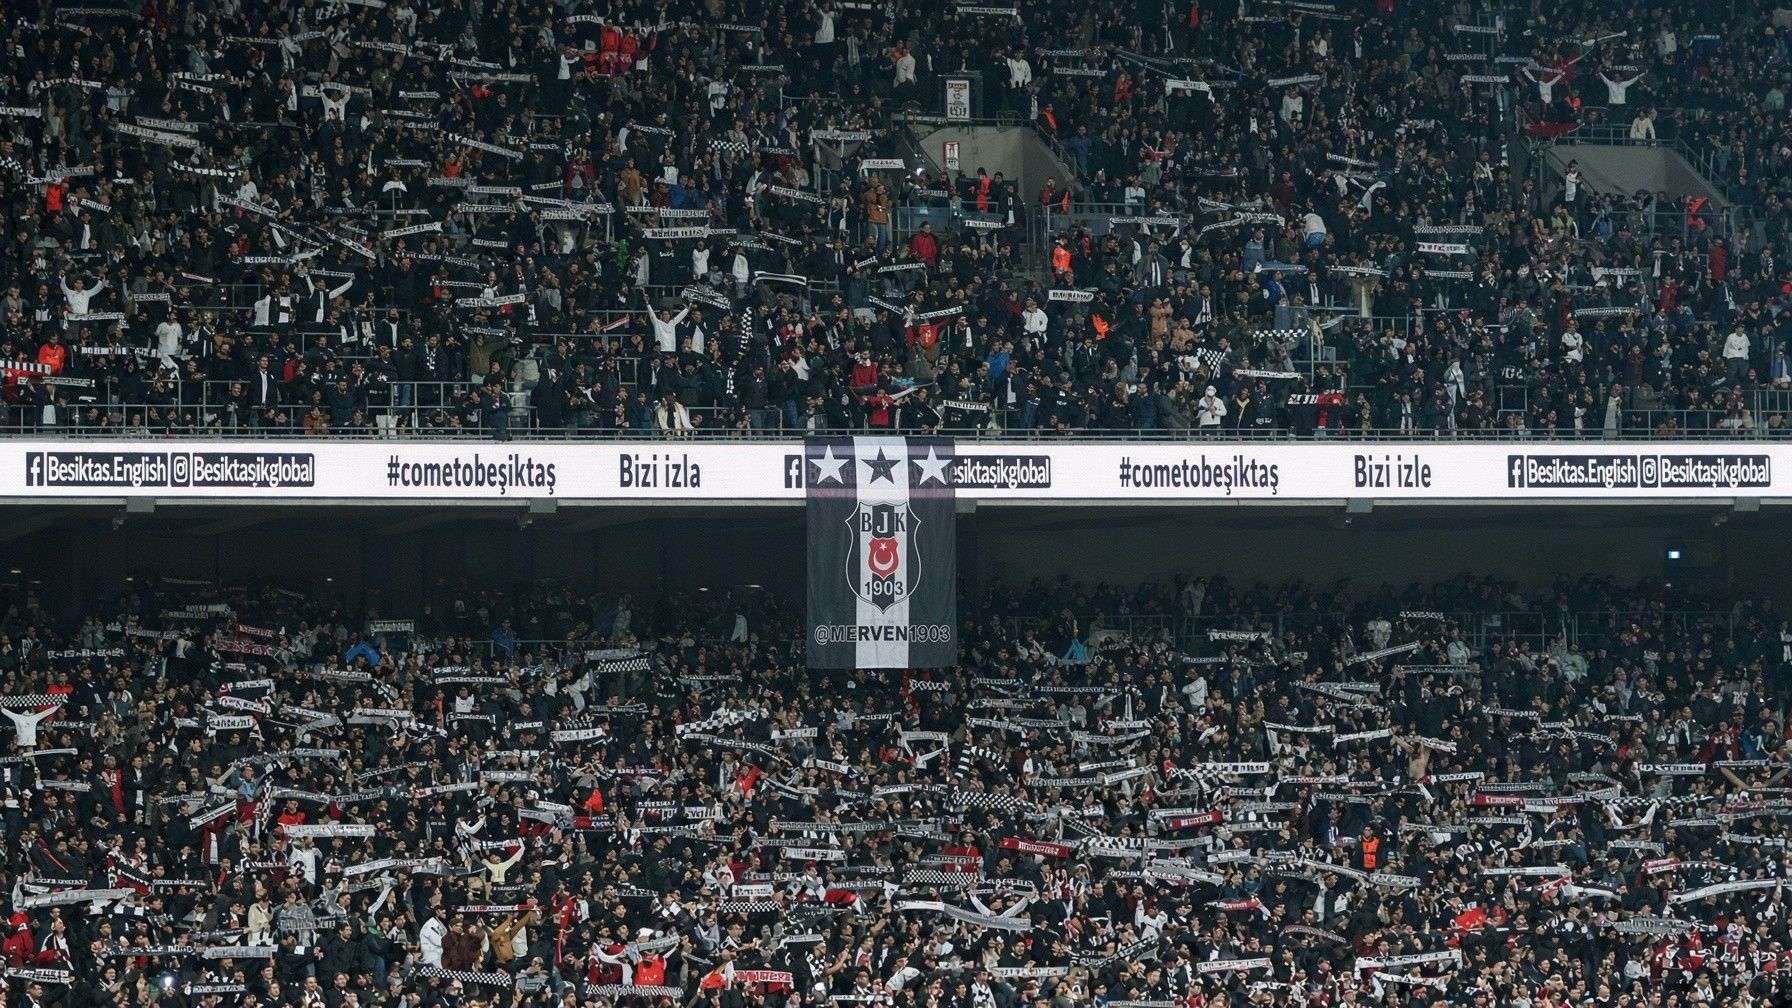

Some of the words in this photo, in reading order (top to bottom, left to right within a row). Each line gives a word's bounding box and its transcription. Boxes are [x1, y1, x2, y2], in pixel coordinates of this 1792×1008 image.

[48, 456, 167, 487] Besiktas.English
[387, 454, 556, 495] #cometobeşiktaş
[620, 454, 658, 488] Bizi
[665, 454, 701, 488] izla
[1119, 455, 1279, 495] #cometobeşiktaş
[1354, 455, 1391, 488] Bizi
[1397, 455, 1432, 488] izle
[1527, 458, 1637, 488] Besiktas.English
[864, 581, 904, 596] 1903
[814, 624, 951, 645] @MERVEN1903
